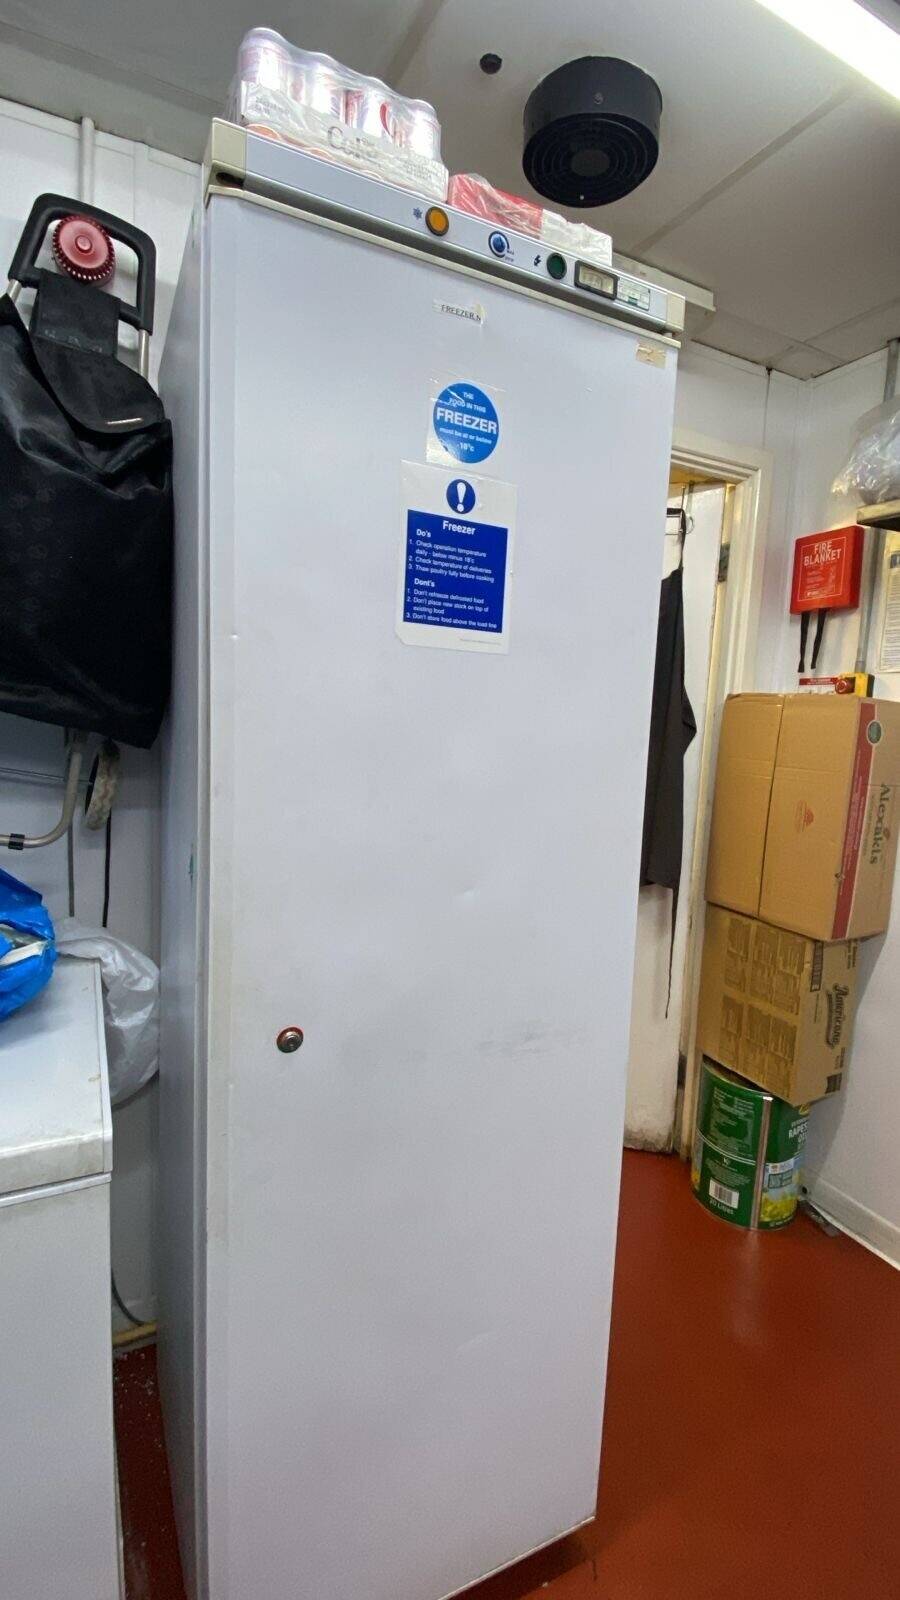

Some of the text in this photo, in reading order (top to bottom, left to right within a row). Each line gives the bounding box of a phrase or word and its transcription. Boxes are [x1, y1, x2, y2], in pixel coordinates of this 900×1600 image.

[441, 304, 476, 320] FREEZER
[463, 392, 474, 400] THE
[474, 405, 486, 413] THIS
[436, 407, 497, 434] FREEZER
[476, 435, 492, 444] below
[416, 529, 431, 538] Do's
[442, 520, 476, 535] Freezer
[416, 540, 432, 548] Check
[434, 544, 457, 553] operation
[458, 548, 487, 558] temperature
[416, 548, 428, 556] daily
[814, 541, 832, 554] FIRE
[804, 548, 841, 566] BLANKET
[433, 559, 462, 569] temperature
[469, 566, 492, 574] deliveries
[430, 567, 448, 576] poultry
[448, 570, 459, 578] fully
[476, 575, 495, 583] cooking
[414, 578, 435, 587] Dont's
[450, 594, 473, 602] defrosted
[870, 784, 892, 864] Alexakis
